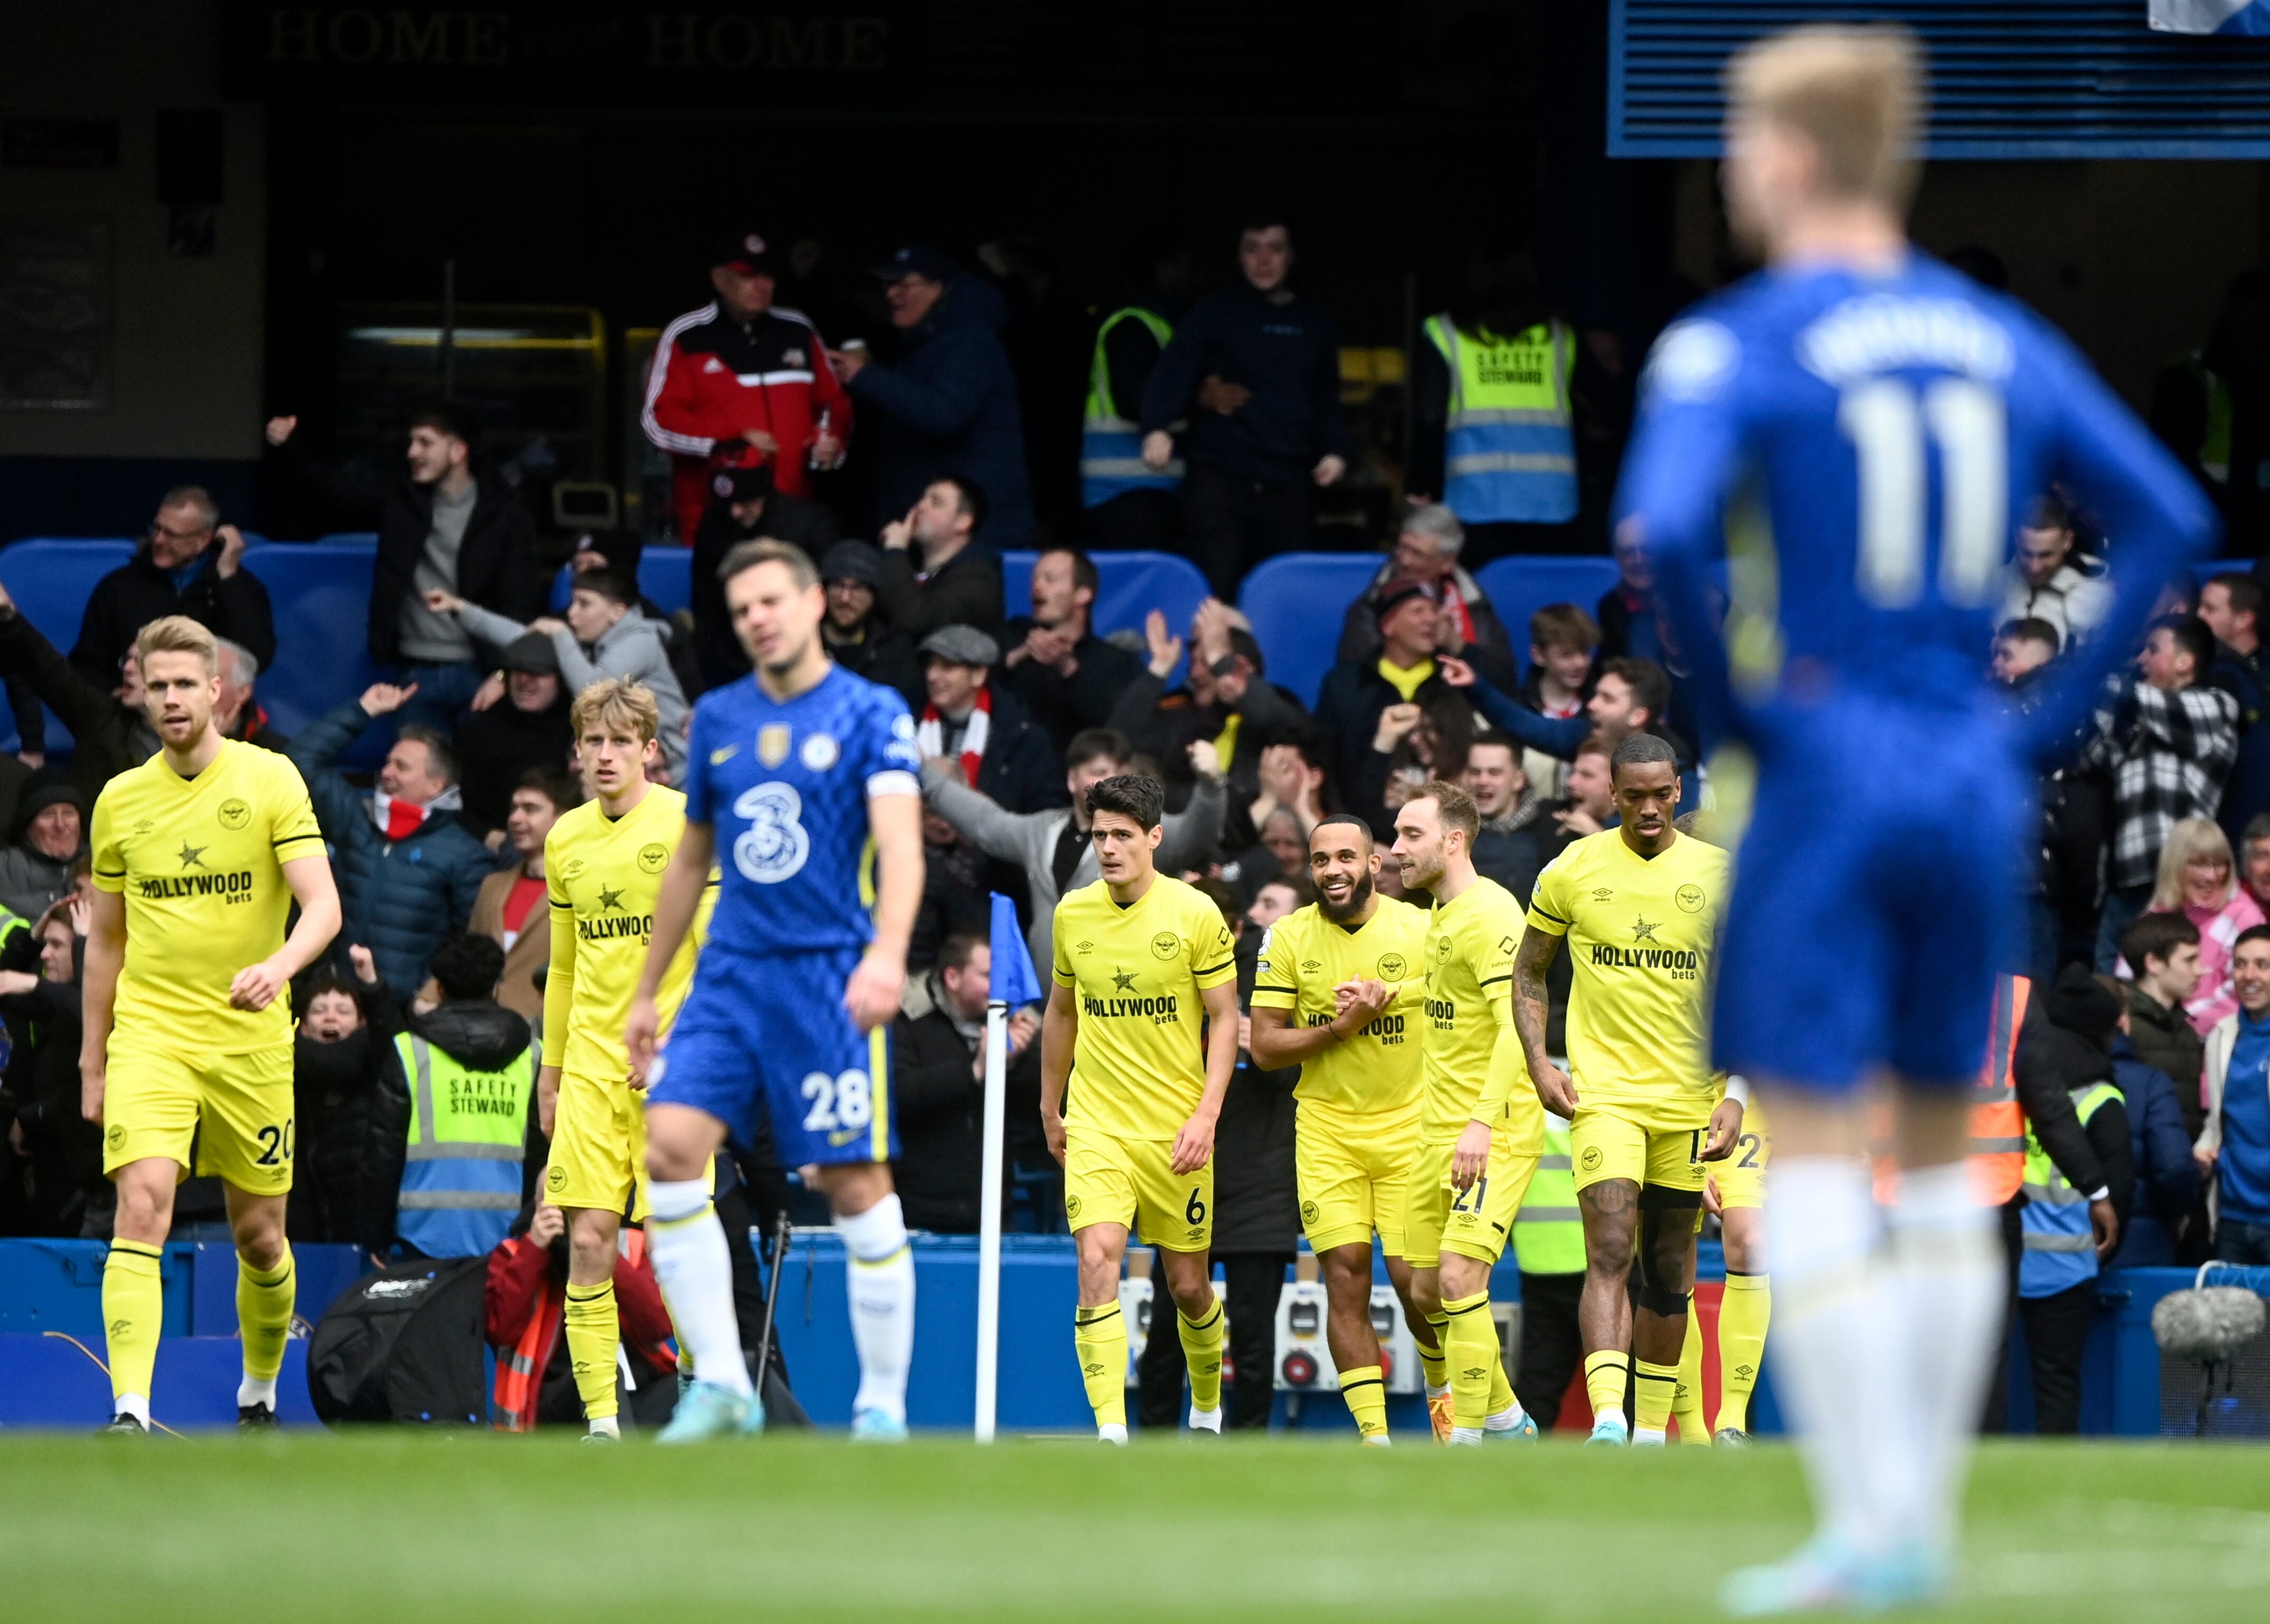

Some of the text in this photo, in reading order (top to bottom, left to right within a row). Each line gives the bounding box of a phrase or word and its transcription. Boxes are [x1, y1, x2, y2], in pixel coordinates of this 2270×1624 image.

[263, 8, 510, 66] HOME
[646, 14, 891, 70] HOME
[1838, 376, 2010, 611] 11
[140, 872, 252, 898] HOLLYWOOD
[226, 893, 252, 904] bets
[1592, 946, 1697, 969] HOLLYWOOD
[1671, 969, 1695, 980] bets
[1084, 995, 1177, 1018] HOLLYWOOD
[1155, 1013, 1178, 1025] bets
[1434, 1018, 1453, 1030] bets
[1382, 1034, 1404, 1045] bets
[450, 1079, 516, 1097] SAFETY
[801, 1068, 873, 1131] 28
[451, 1098, 515, 1117] STEWARD
[256, 1118, 295, 1165] 20
[1186, 1187, 1205, 1225] 6
[1452, 1177, 1488, 1214] 21
